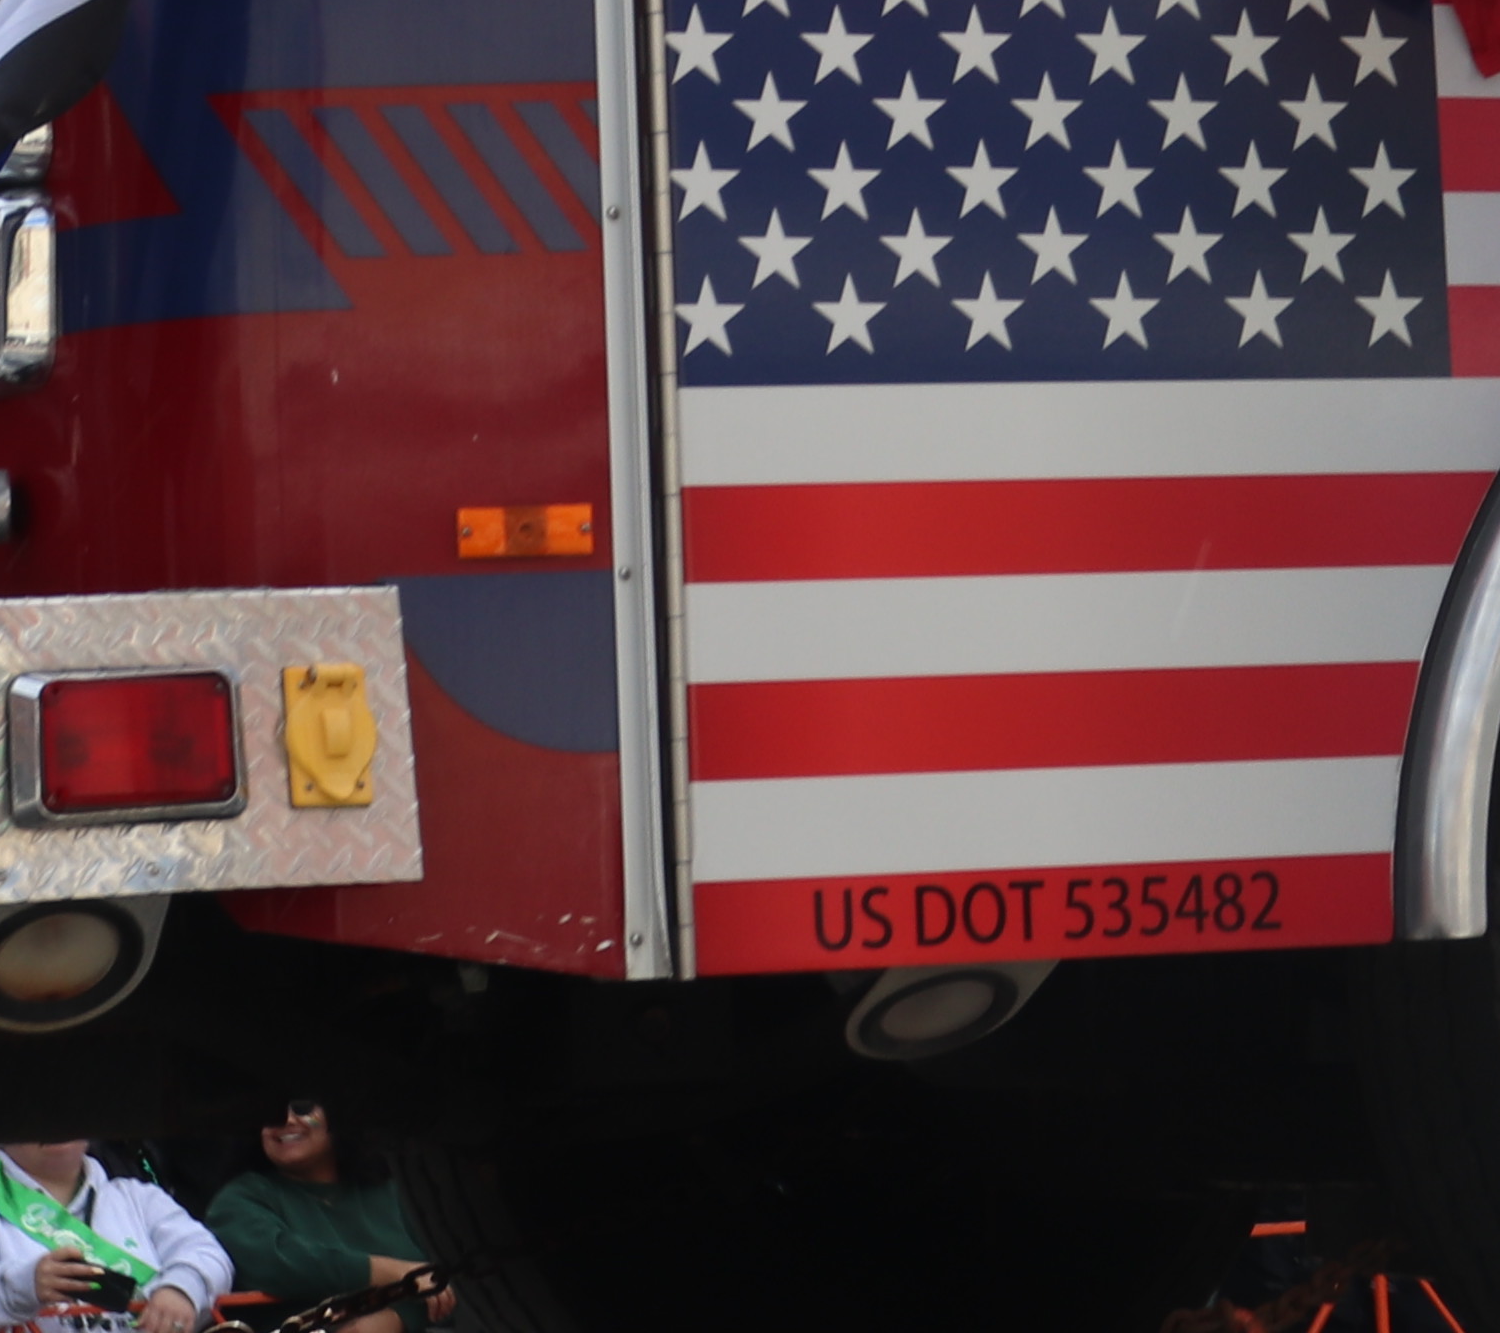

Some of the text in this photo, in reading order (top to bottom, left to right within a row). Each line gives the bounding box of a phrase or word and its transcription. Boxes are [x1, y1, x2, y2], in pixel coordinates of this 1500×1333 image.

[813, 870, 1283, 951] US DOT 535482
